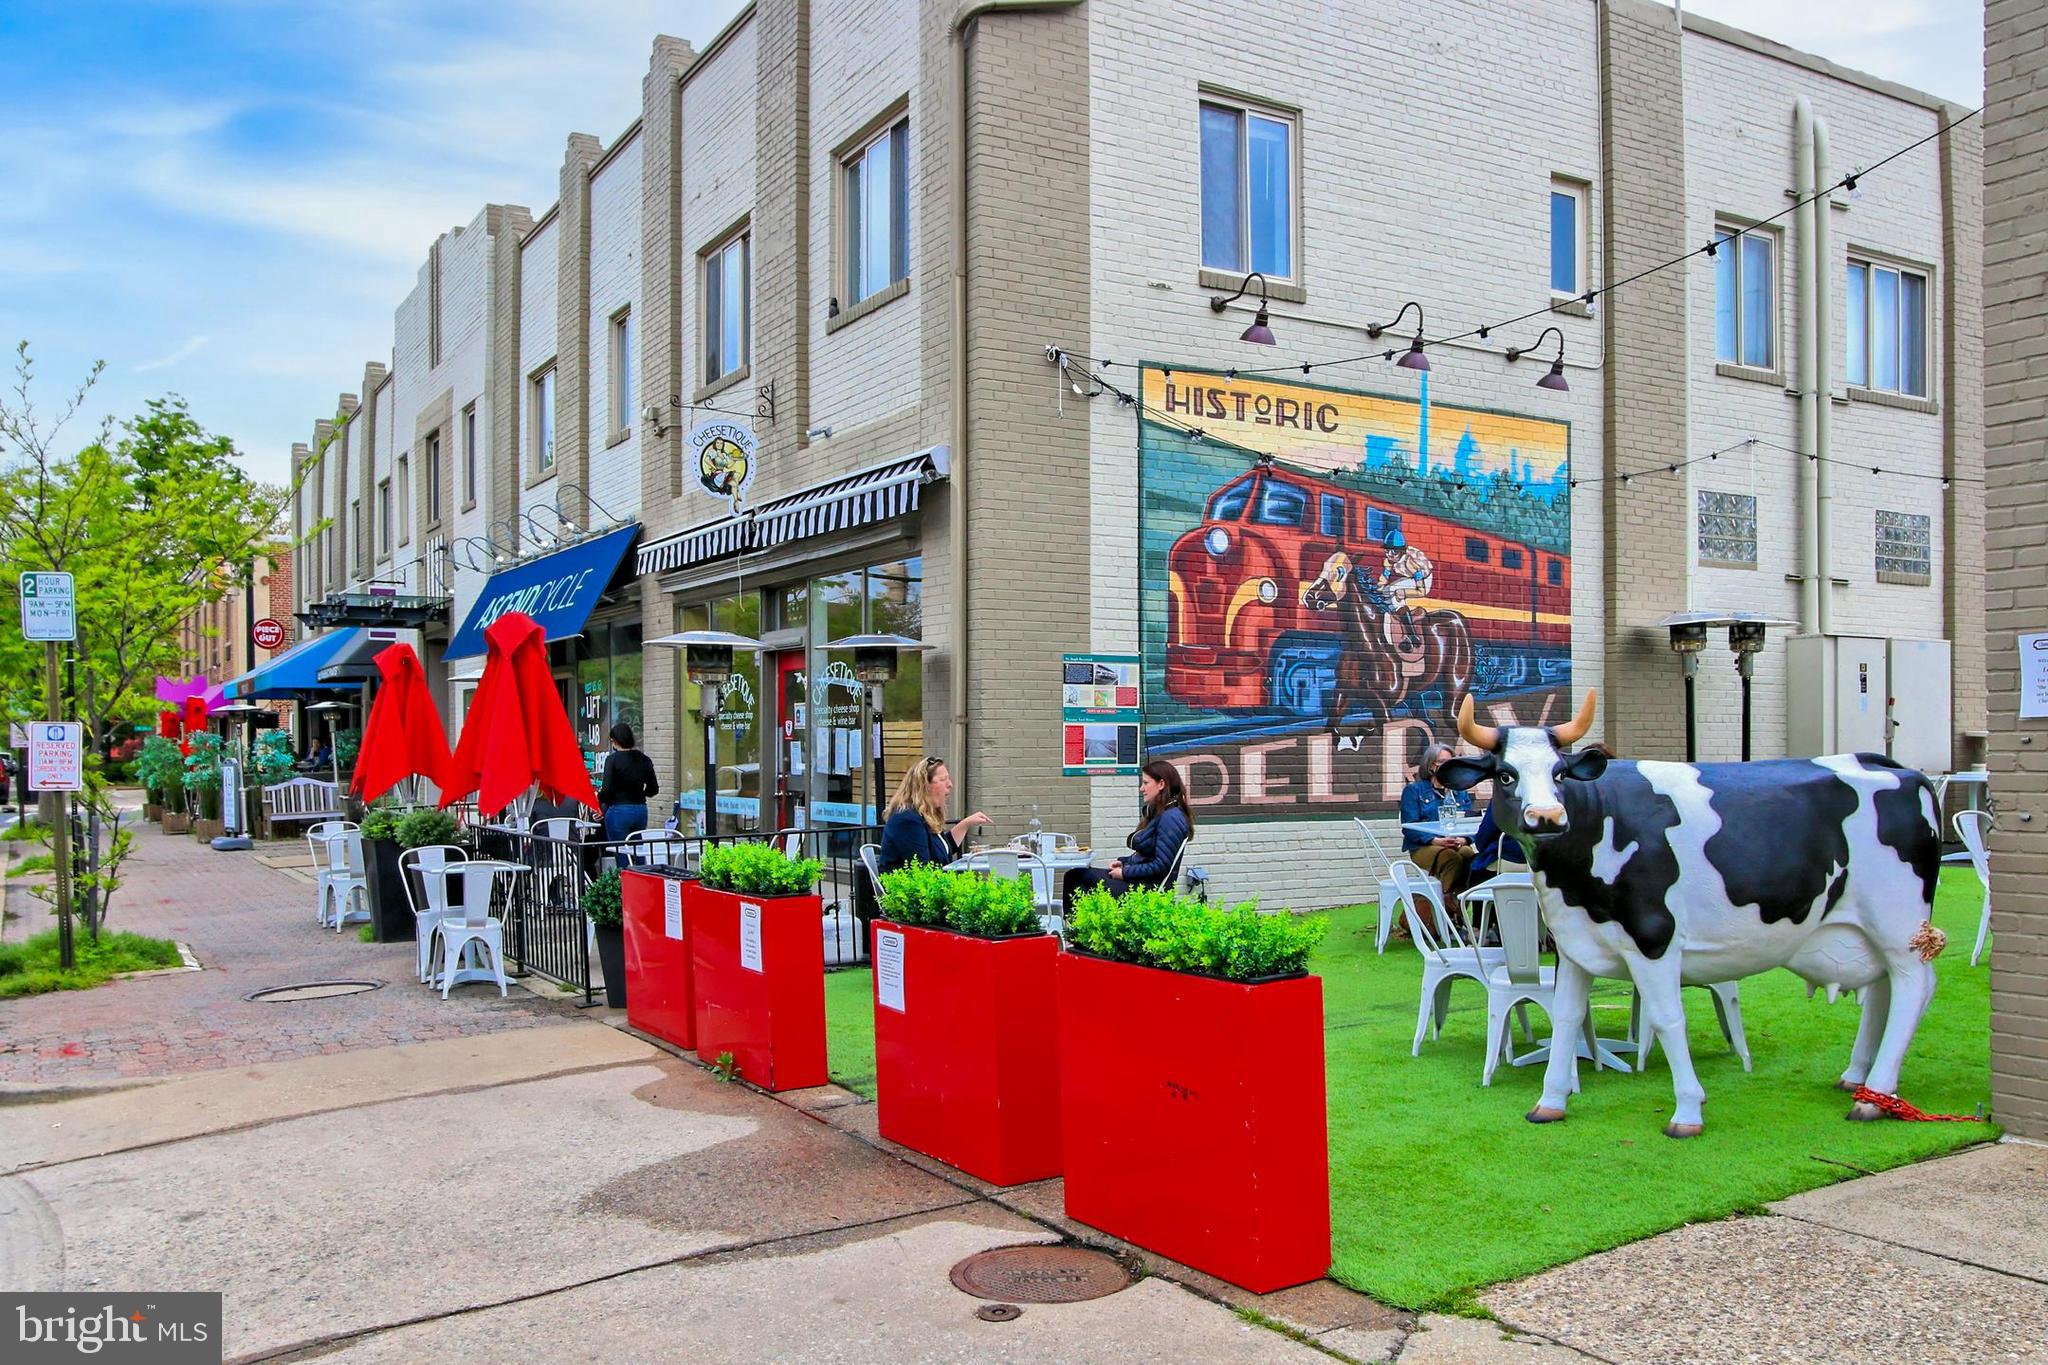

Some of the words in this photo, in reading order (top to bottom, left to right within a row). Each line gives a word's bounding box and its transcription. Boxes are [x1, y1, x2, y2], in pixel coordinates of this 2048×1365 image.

[1166, 384, 1340, 433] HISTORIC
[692, 425, 754, 450] CHEESETIQUE
[24, 578, 36, 594] 2
[38, 577, 61, 586] HOUR
[38, 587, 71, 595] PARKING
[812, 660, 862, 705] CHEESETIQUE
[36, 742, 76, 750] RESERVED
